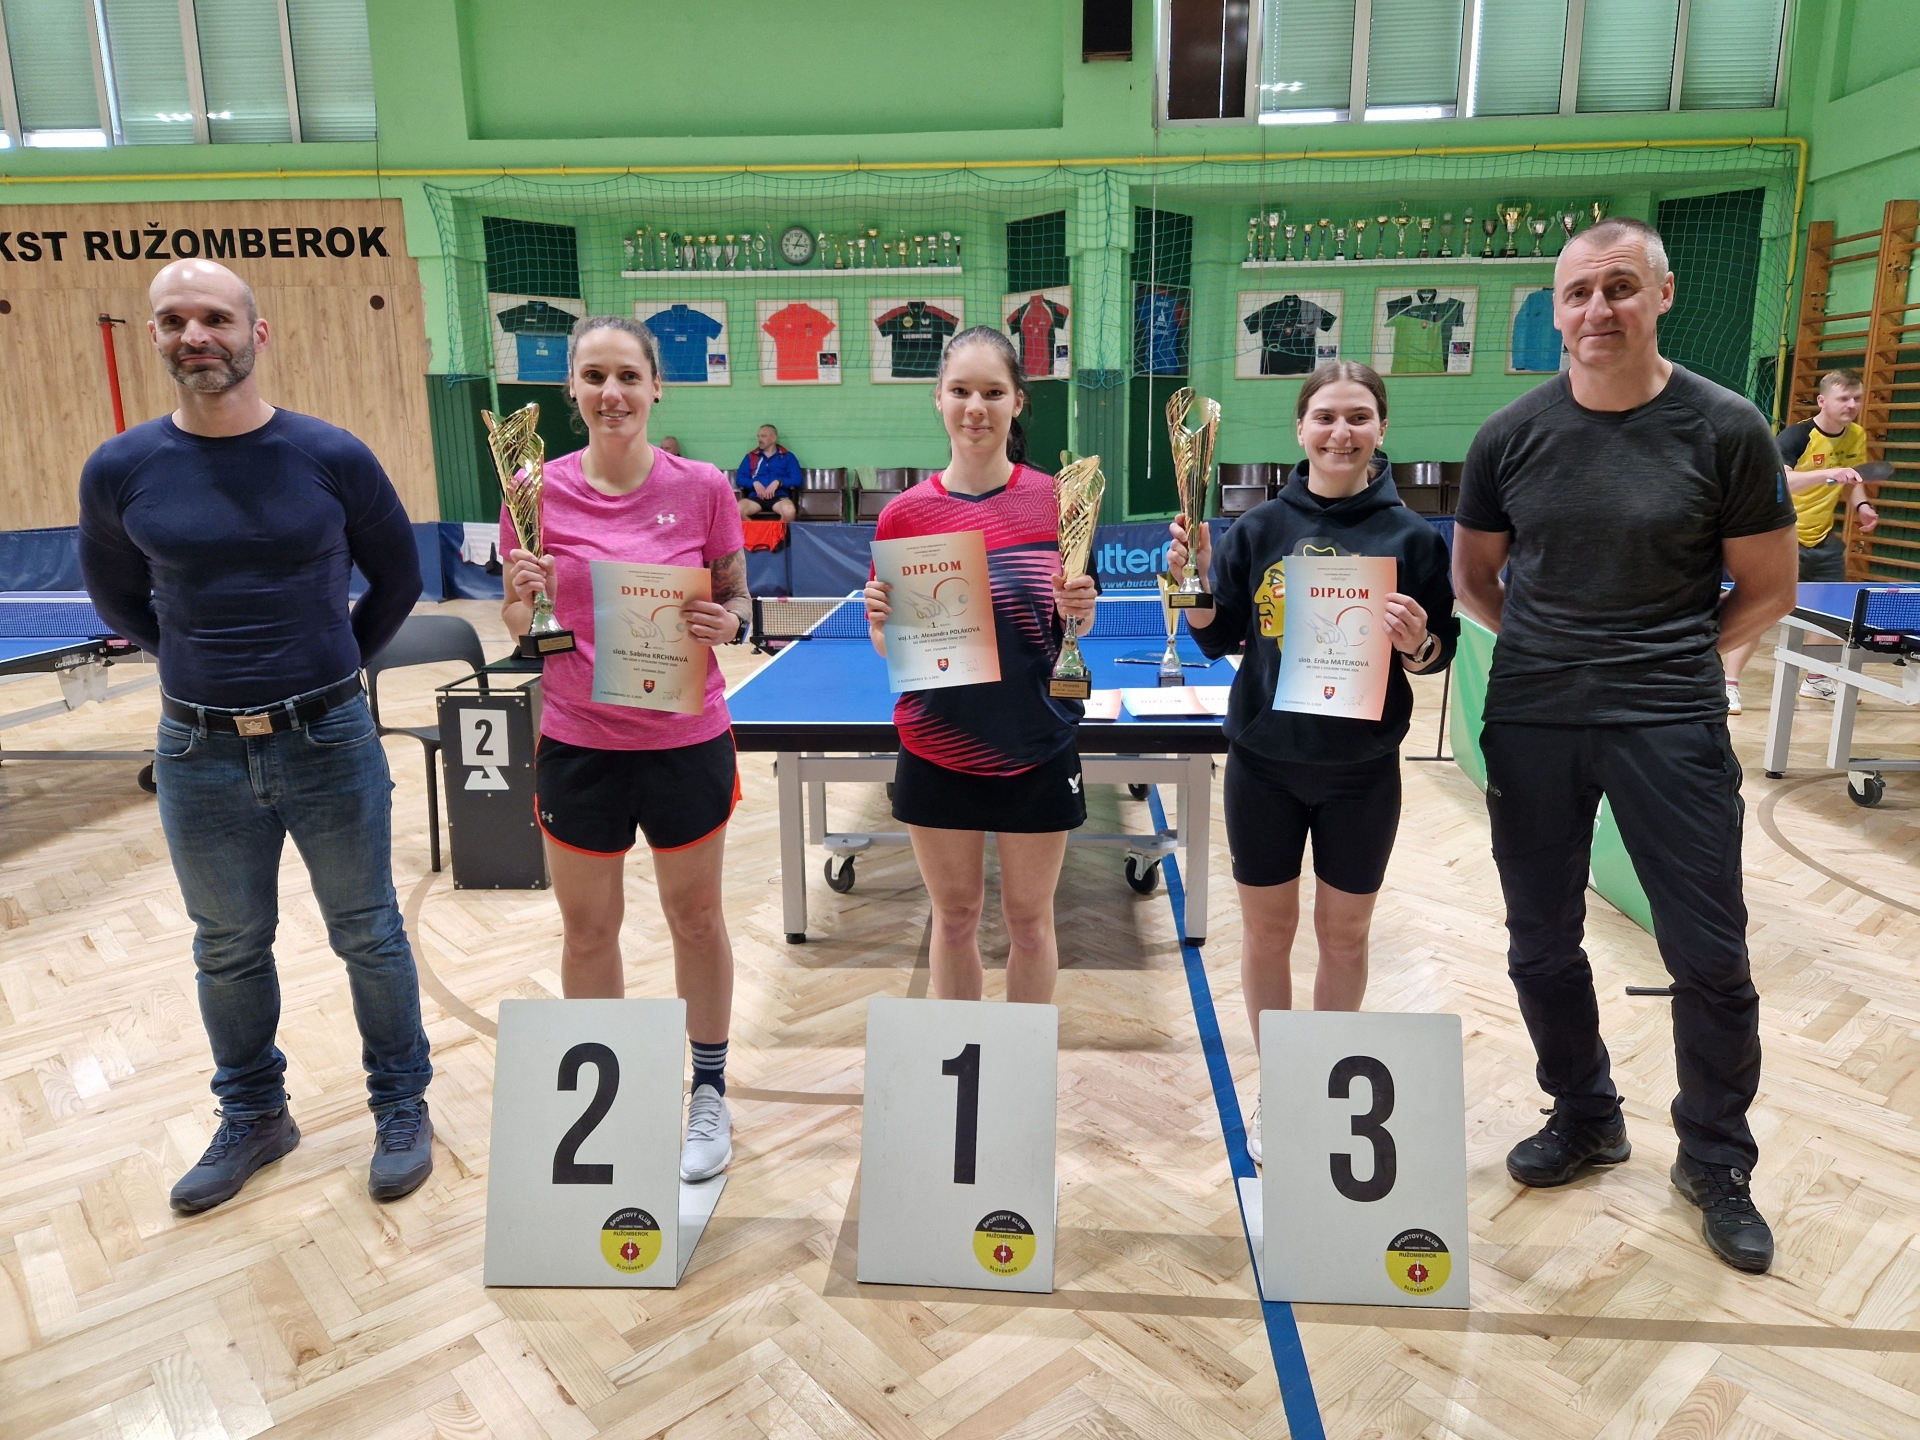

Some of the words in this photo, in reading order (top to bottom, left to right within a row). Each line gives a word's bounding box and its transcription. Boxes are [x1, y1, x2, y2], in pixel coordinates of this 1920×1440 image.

[83, 222, 390, 260] RUŽOMBEROK
[901, 560, 962, 576] DIPLOM
[621, 586, 684, 600] DIPLOM
[1310, 587, 1369, 600] DIPLOM
[921, 631, 949, 639] Alexandra
[950, 626, 980, 636] POLÁKOVÁ
[613, 648, 628, 656] slob.
[630, 650, 651, 659] Sabina
[652, 652, 688, 663] KRCHNAVÁ
[1331, 659, 1369, 667] MATEJKOVÁ
[475, 719, 494, 756] 2
[552, 1043, 619, 1184] 2
[942, 1044, 980, 1184] 1
[1328, 1056, 1396, 1202] 3
[638, 1214, 652, 1226] KLUB
[1012, 1217, 1025, 1230] KLUB
[986, 1232, 1023, 1240] RUŽOMBEROK
[1425, 1236, 1439, 1248] KLUB
[989, 1265, 1018, 1273] SLOVENSKO
[1404, 1285, 1434, 1293] SLOVENSKO
